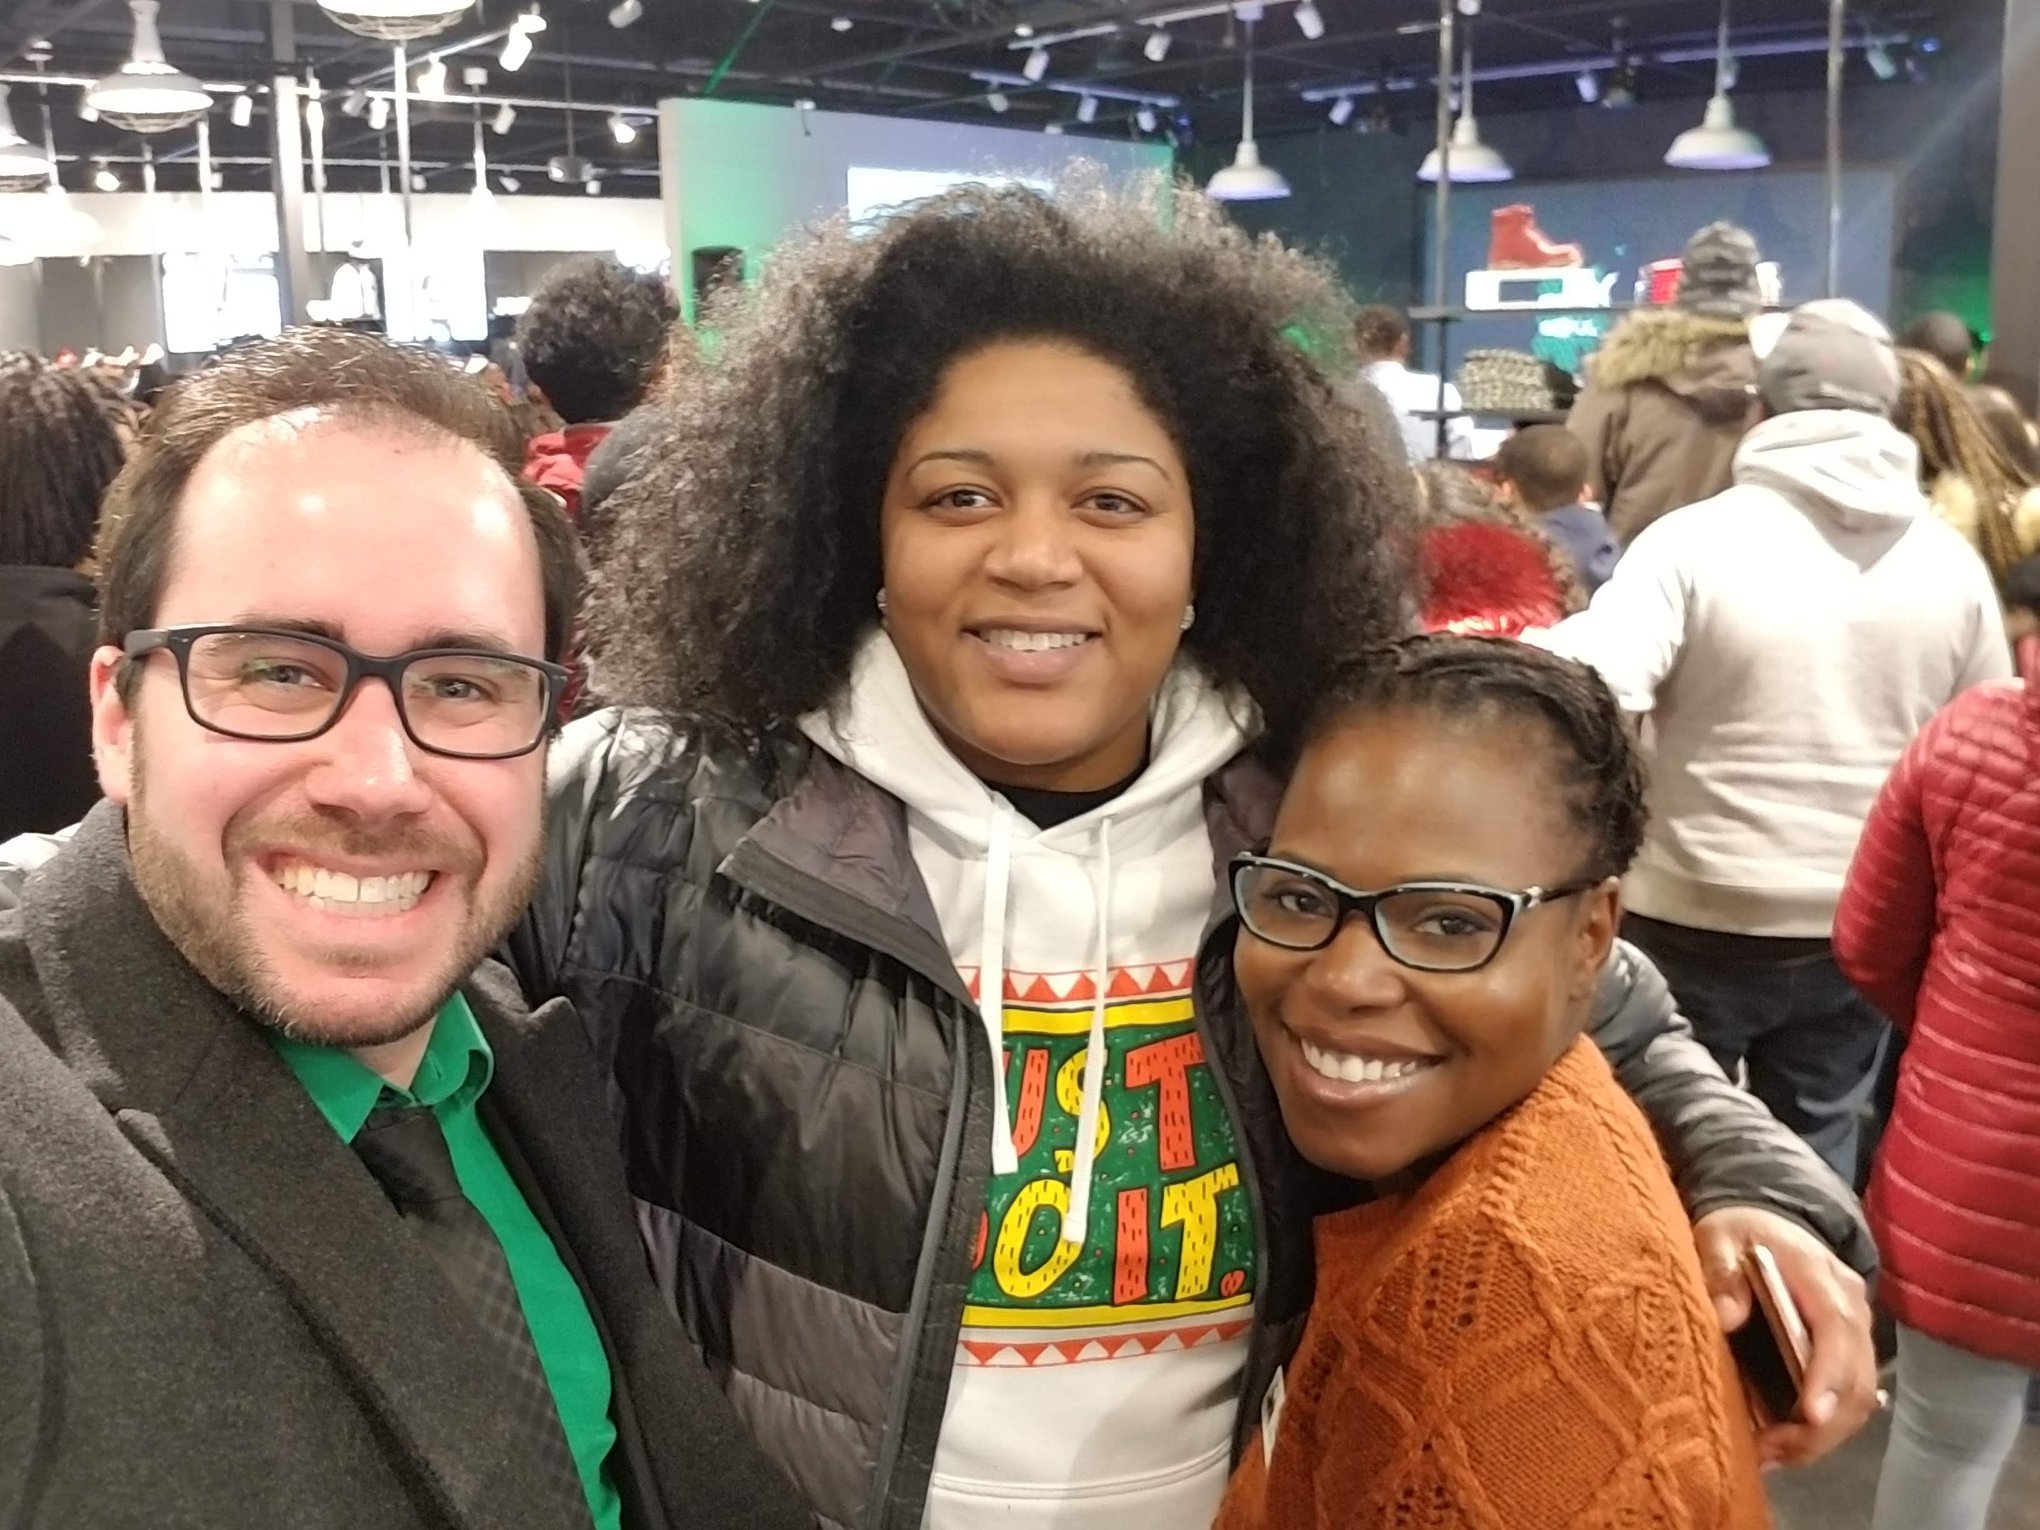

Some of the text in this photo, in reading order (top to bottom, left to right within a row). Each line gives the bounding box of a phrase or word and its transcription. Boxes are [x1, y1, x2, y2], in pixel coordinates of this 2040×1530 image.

[1002, 1031, 1207, 1172] UST
[972, 1162, 1246, 1306] O IT.
